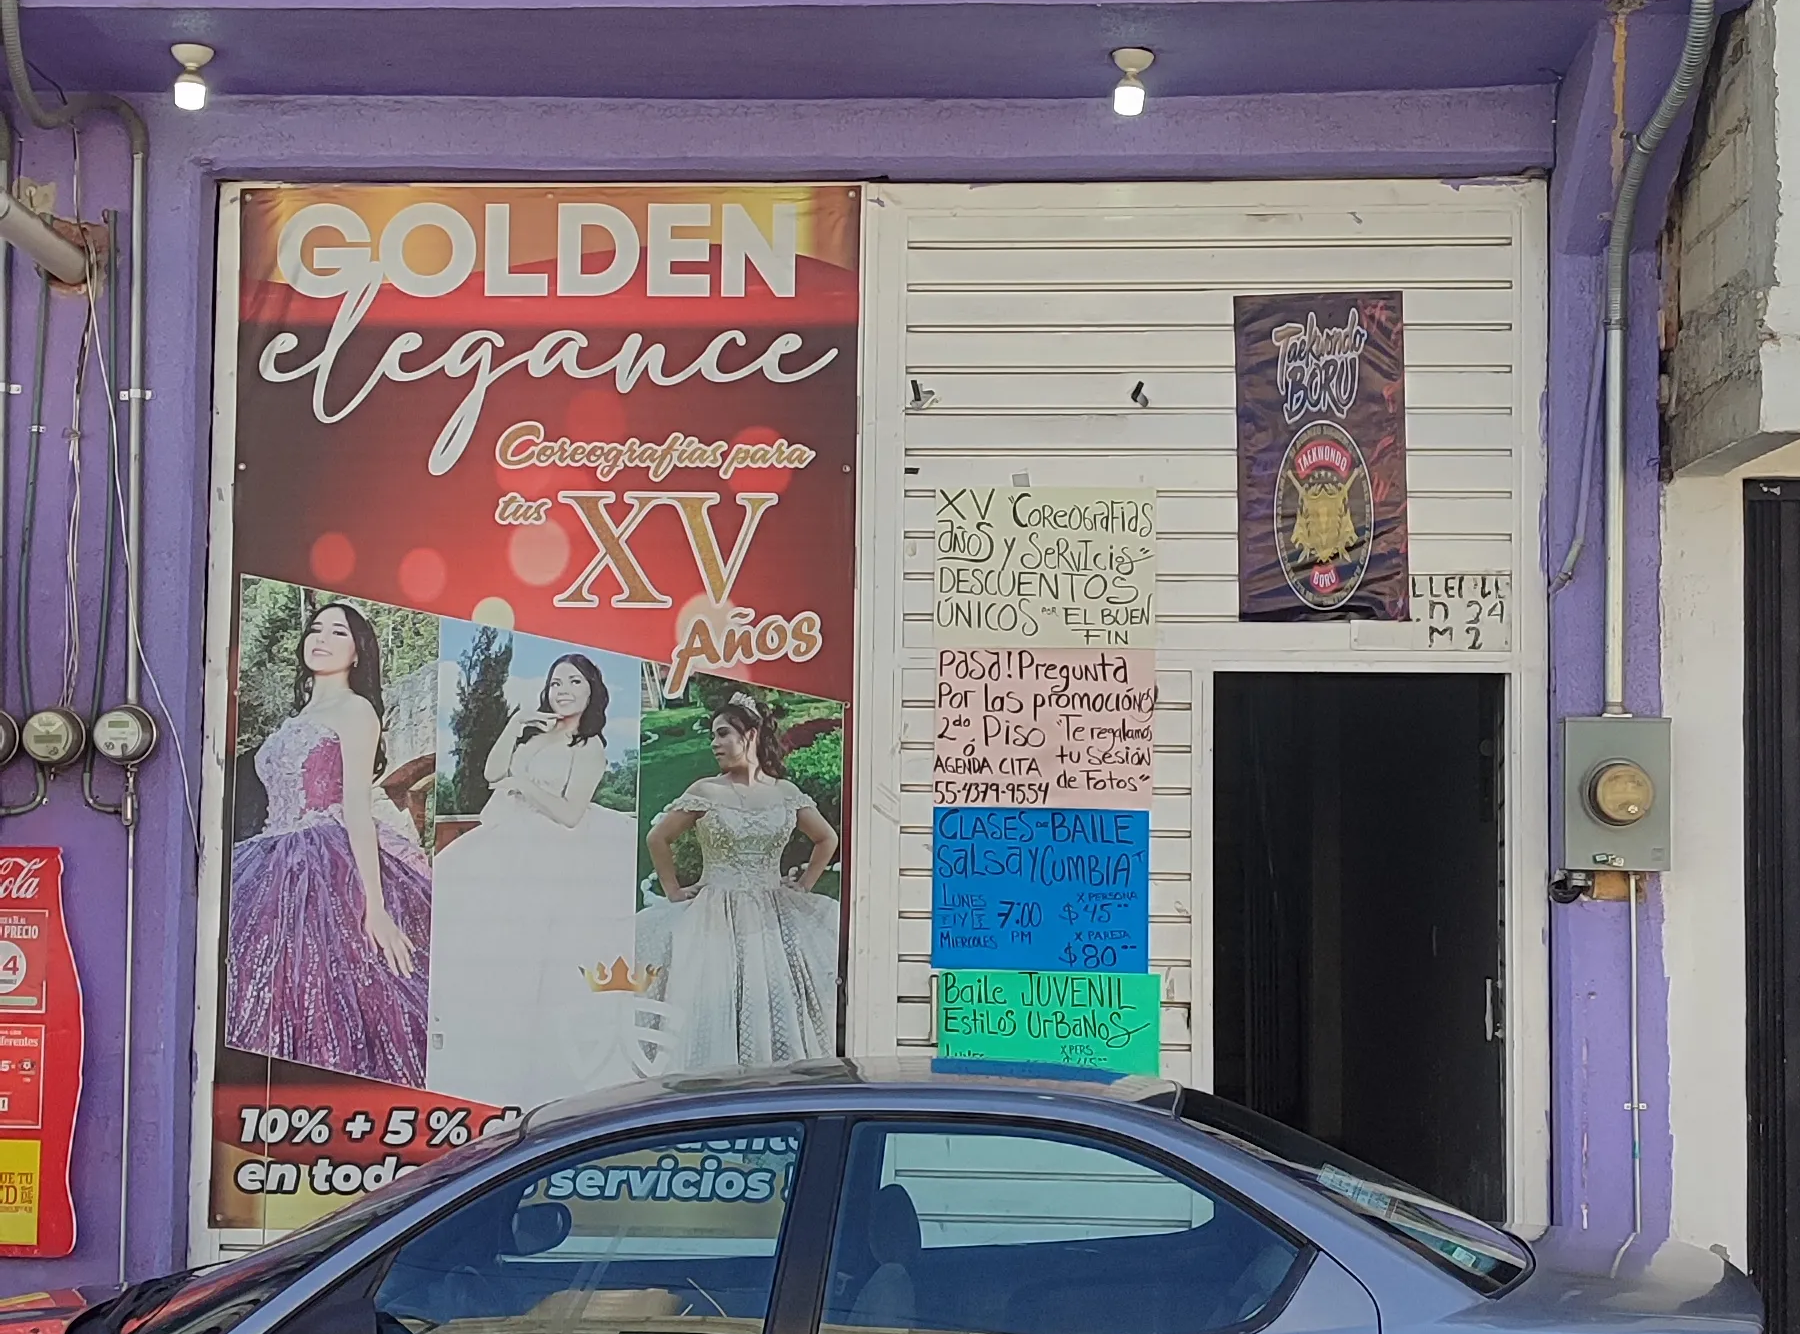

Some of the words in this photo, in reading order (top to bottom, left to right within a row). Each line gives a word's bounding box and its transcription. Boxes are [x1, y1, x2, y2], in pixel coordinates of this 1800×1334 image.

[277, 202, 797, 299] GOLDEN
[258, 261, 839, 476] elegance
[719, 438, 817, 480] para
[1297, 444, 1348, 472] TAEKWONDO
[936, 488, 995, 520] XV
[495, 491, 552, 525] tus
[553, 490, 779, 609] XV
[939, 566, 1140, 605] DESCUENTOS
[1312, 567, 1336, 589] BORU
[936, 595, 1039, 637] ÚNICOS
[1062, 606, 1096, 626] EL
[1100, 593, 1154, 626] BUEN
[663, 608, 822, 699] Años
[1070, 628, 1129, 646] FIN
[933, 755, 994, 776] AGENDA
[999, 757, 1043, 778] CITA
[1056, 770, 1078, 790] de
[938, 808, 1035, 844] CLASES
[1051, 811, 1135, 845] BAILE
[4, 925, 39, 939] PRECIO
[997, 900, 1043, 929] 7:00
[1010, 930, 1032, 945] PM
[1018, 971, 1137, 1009] JUVENIL
[240, 1107, 331, 1145] 10%
[17, 1172, 33, 1185] TU
[236, 1161, 299, 1192] en
[548, 1156, 775, 1201] servicios
